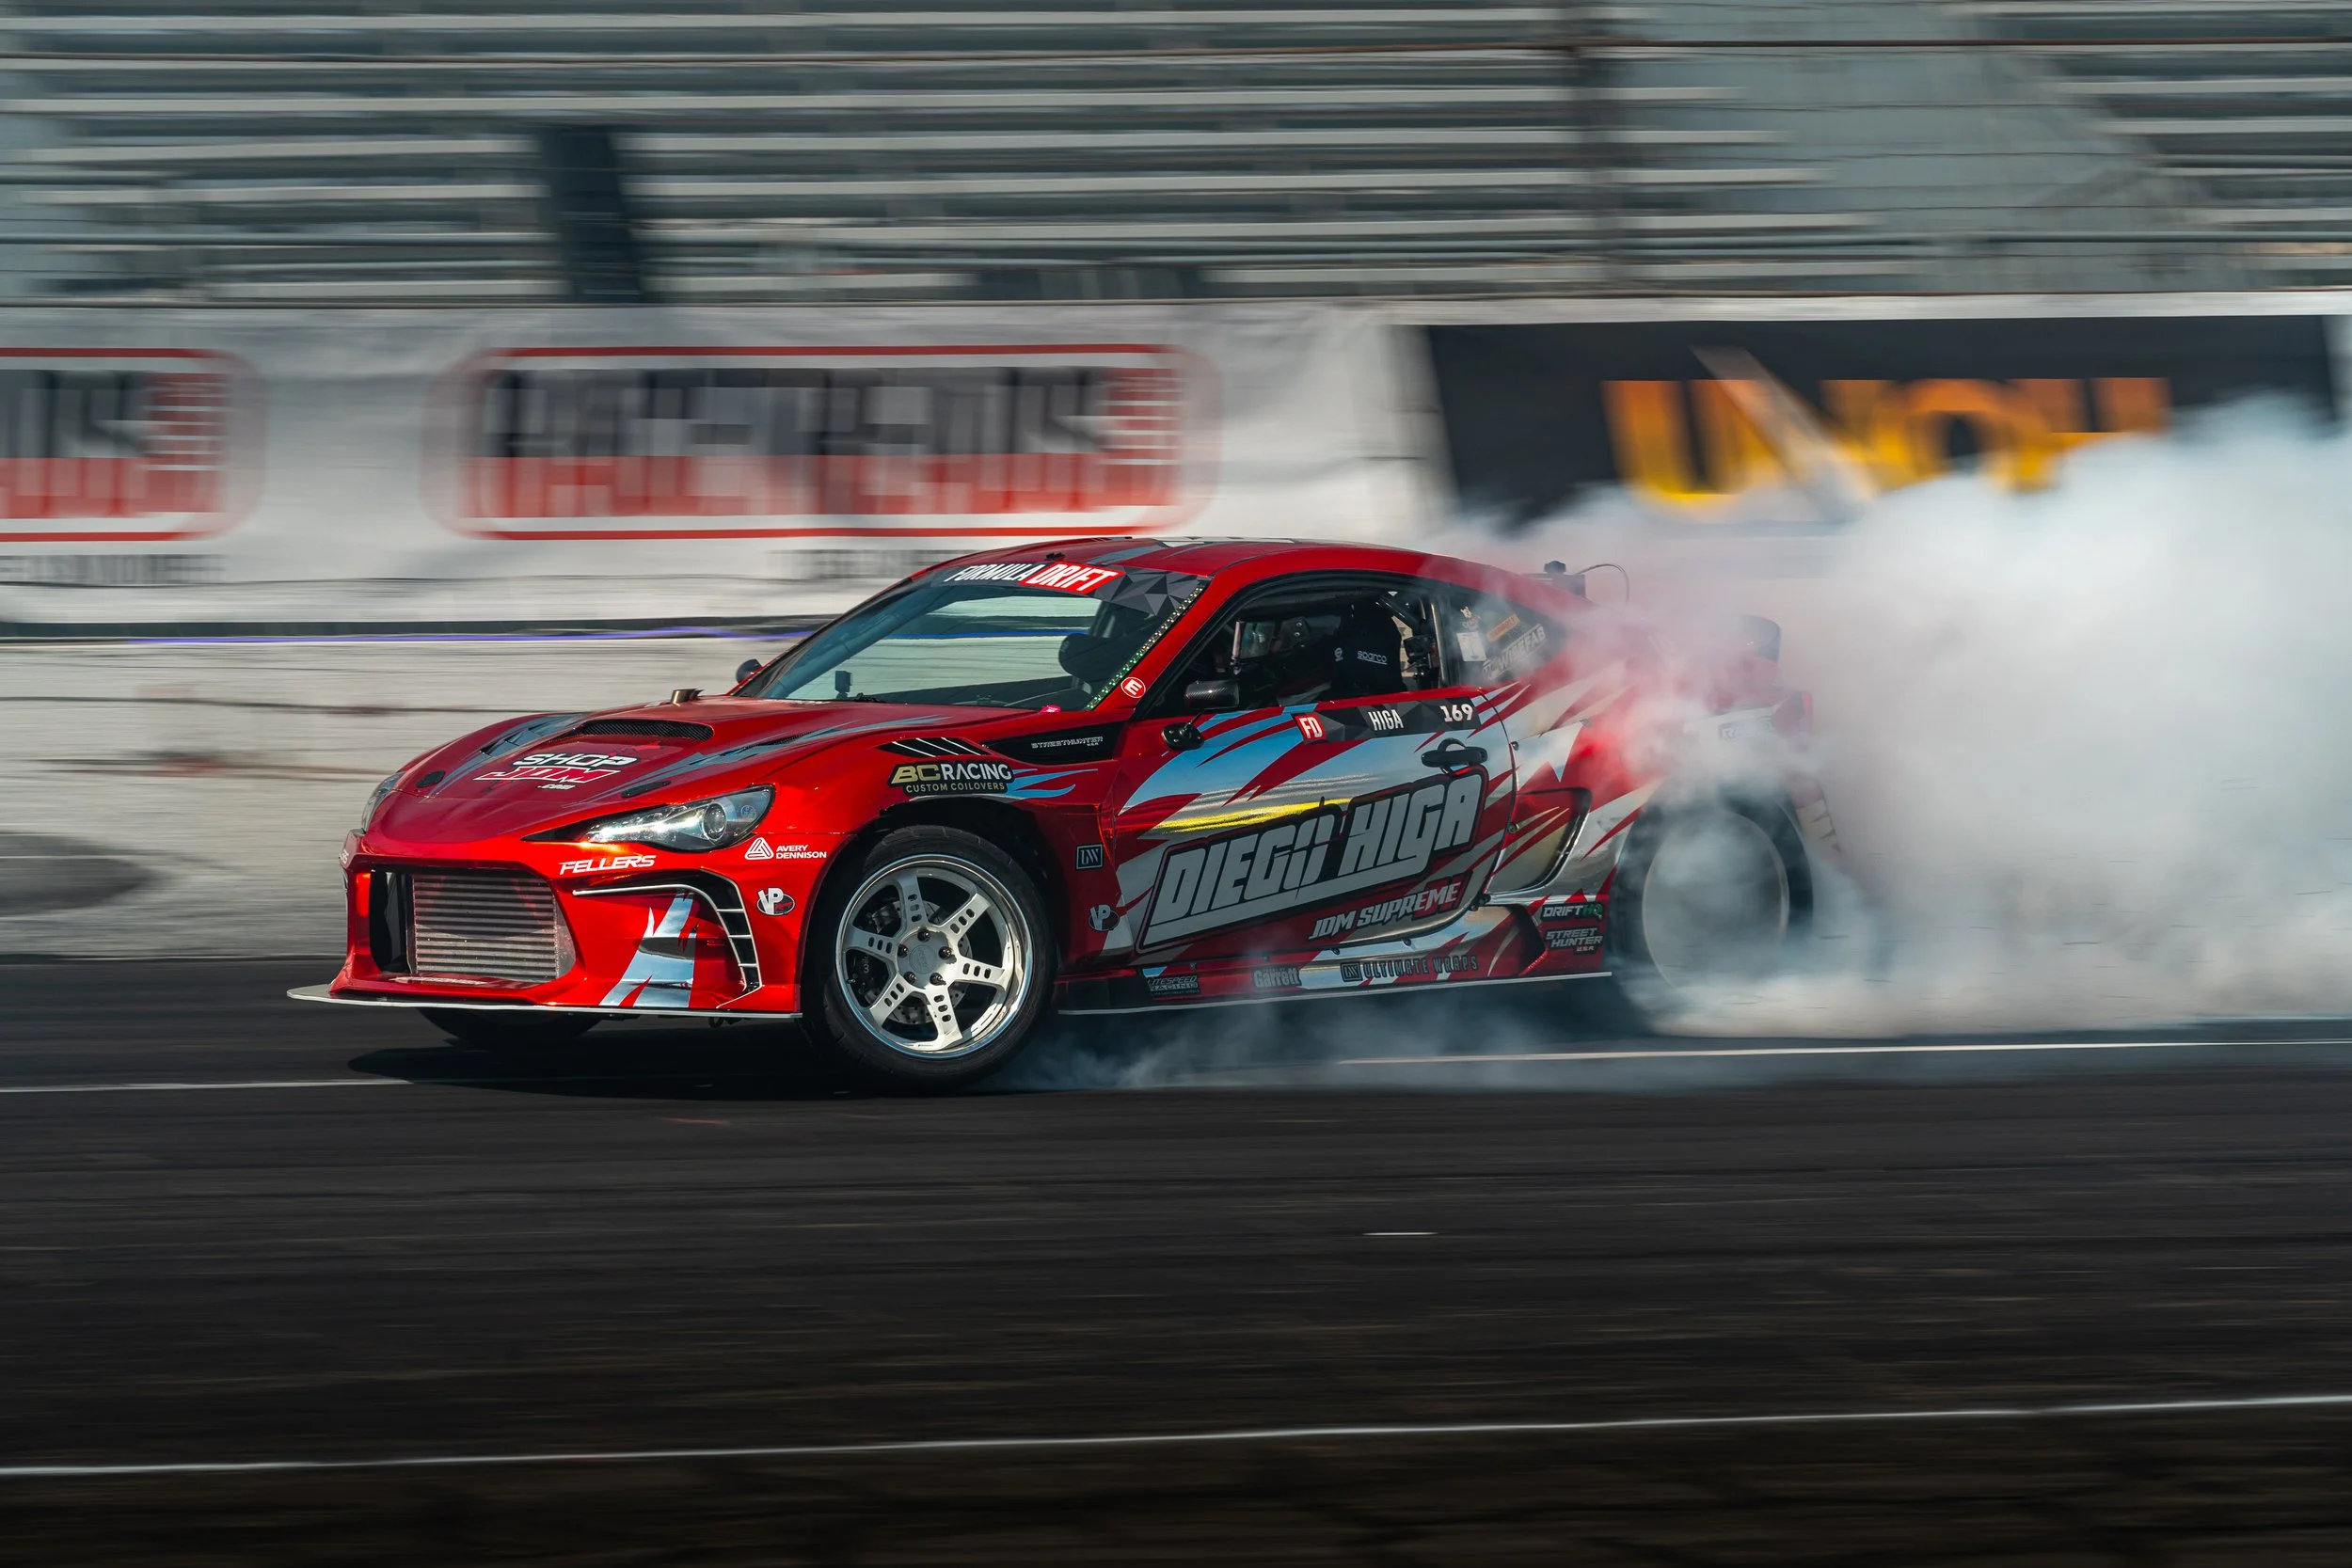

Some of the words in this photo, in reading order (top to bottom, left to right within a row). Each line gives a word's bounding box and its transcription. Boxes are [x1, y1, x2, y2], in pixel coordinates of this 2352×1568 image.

[944, 563, 1046, 582] FORMULA
[1025, 563, 1118, 591] DRIFT
[1357, 650, 1387, 663] sparco
[1299, 717, 1323, 738] FD
[1368, 709, 1404, 731] HIGA
[1439, 704, 1473, 722] 169
[513, 753, 637, 768] SHOP
[472, 766, 622, 784] JDM
[906, 783, 948, 793] CUSTOM
[950, 782, 1005, 792] COILOVERS
[1338, 773, 1482, 877] HIGA
[775, 851, 827, 860] DENNISON
[776, 844, 808, 852] AVERY
[559, 854, 656, 875] FELLERS
[758, 888, 784, 915] VP
[1309, 910, 1357, 940] JDM
[1358, 882, 1461, 927] SUPREME
[1089, 905, 1111, 931] VP
[1546, 927, 1597, 940] STREET
[1550, 935, 1603, 948] HUNTER
[1362, 959, 1428, 978] ULTIMATE
[1434, 956, 1478, 974] WRAPS
[1253, 968, 1300, 988] Garrett
